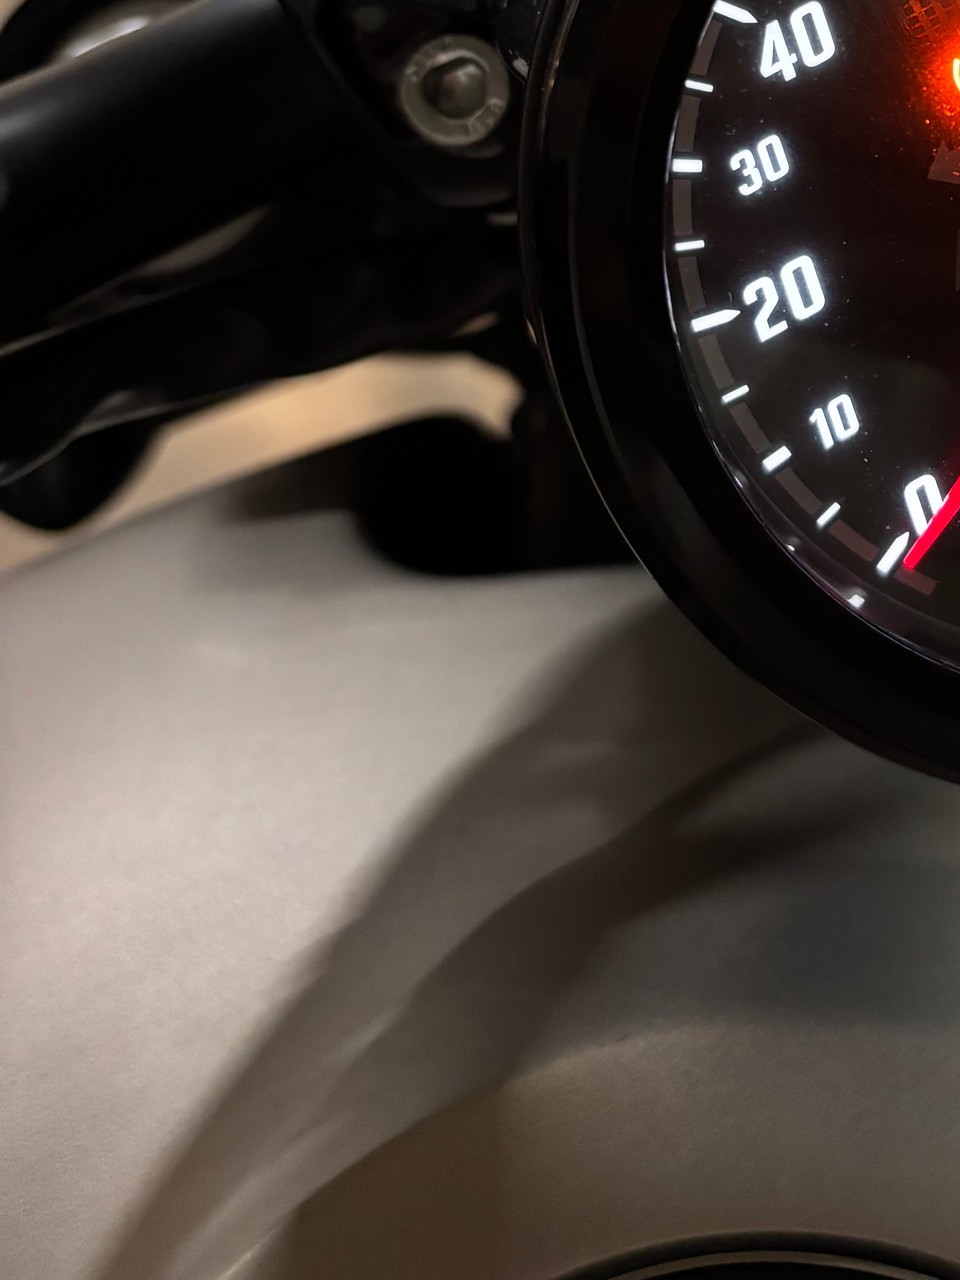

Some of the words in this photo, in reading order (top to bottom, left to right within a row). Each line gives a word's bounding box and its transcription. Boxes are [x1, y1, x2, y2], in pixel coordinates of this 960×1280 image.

[758, 0, 837, 83] 40
[729, 134, 790, 196] 30
[742, 255, 827, 344] 20
[808, 393, 861, 450] 10
[903, 473, 945, 537] 0
